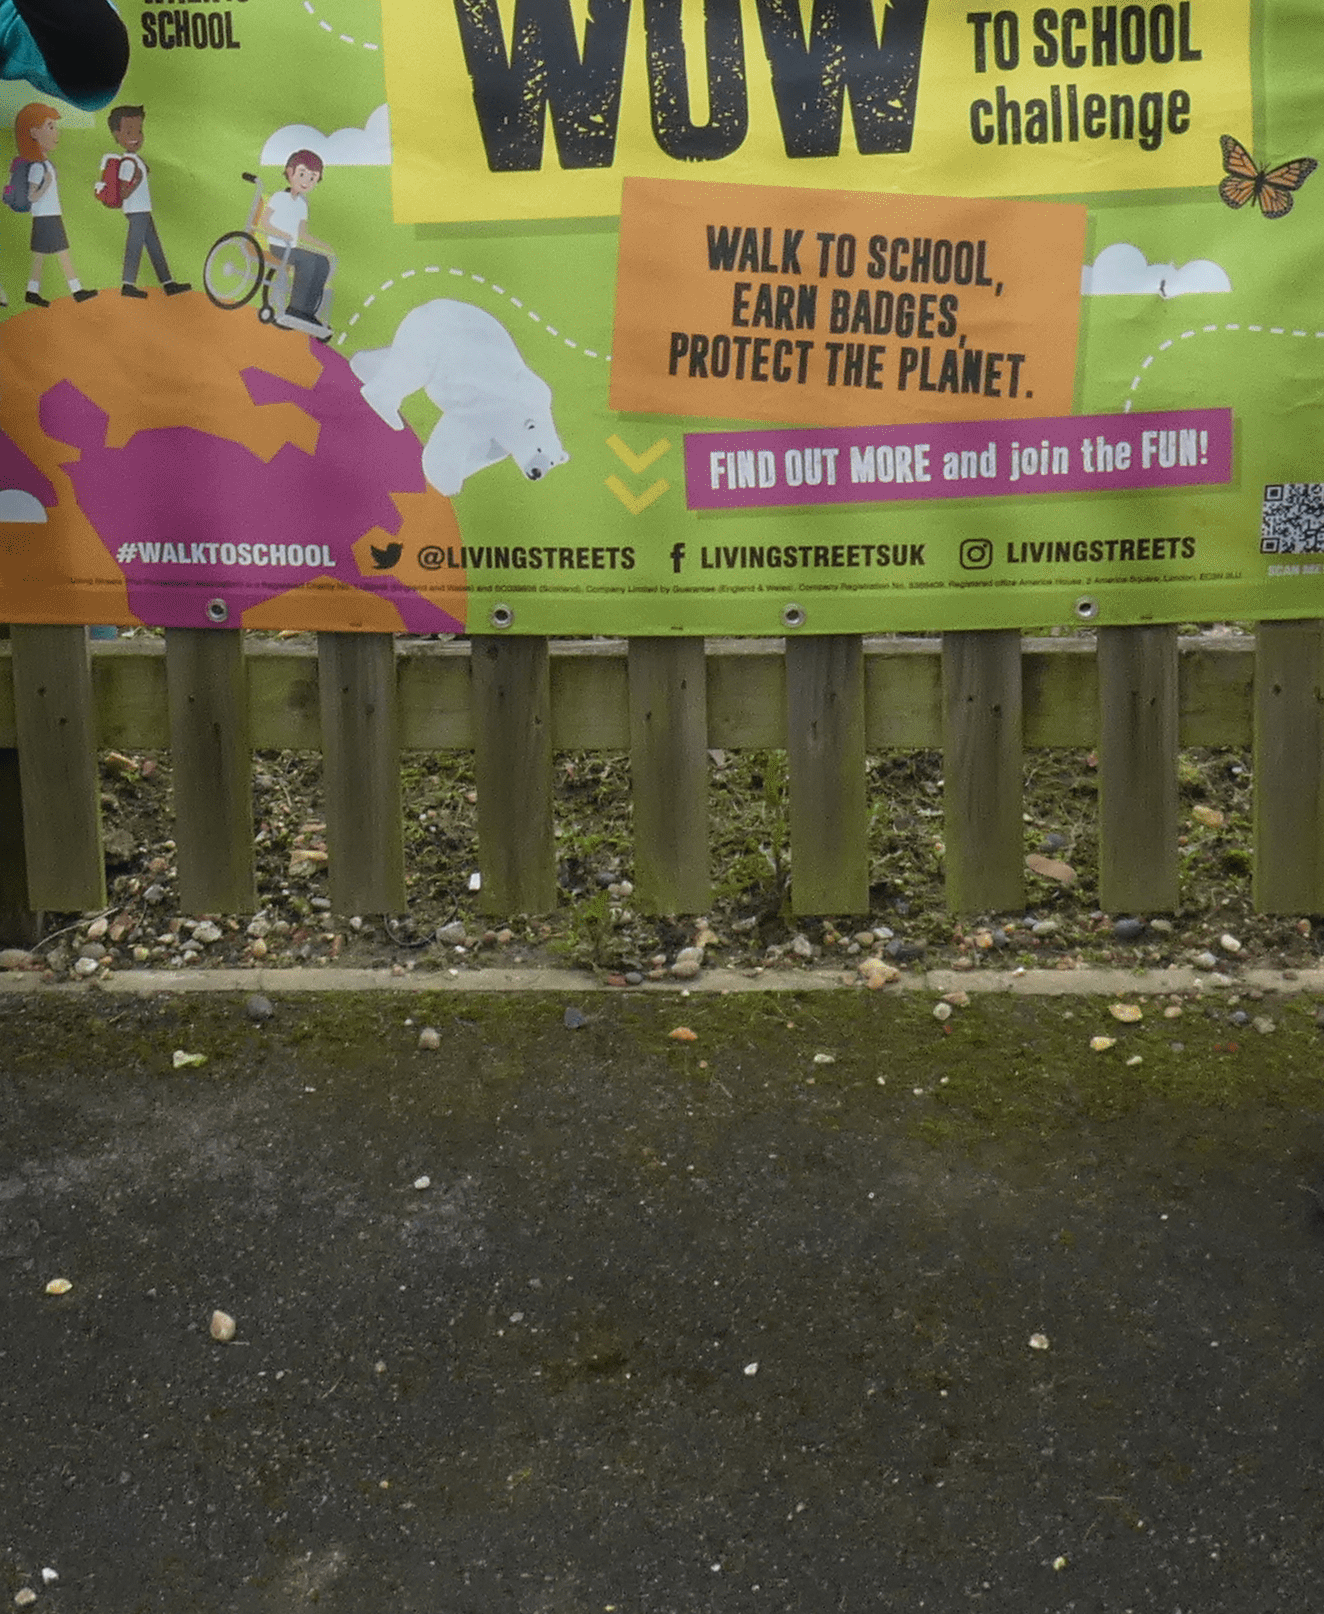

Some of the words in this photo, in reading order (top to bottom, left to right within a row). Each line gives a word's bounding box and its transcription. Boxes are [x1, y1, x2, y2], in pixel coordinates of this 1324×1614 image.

[141, 11, 241, 50] SCHOOL
[967, 12, 1020, 73] TO
[1033, 2, 1201, 68] SCHOOL
[969, 84, 1191, 152] challenge
[707, 224, 804, 276] WALK
[817, 231, 855, 278] TO
[867, 234, 1004, 296] SCHOOL,
[732, 283, 817, 332] EARN
[829, 287, 967, 349] BADGES,
[669, 331, 810, 384] PROTECT
[825, 340, 883, 389] THE
[898, 346, 1034, 398] PLANET.
[709, 449, 776, 491] FIND
[784, 446, 838, 487] OUT
[850, 444, 931, 485] MORE
[942, 442, 997, 481] and
[1009, 438, 1069, 481] join
[1080, 433, 1132, 473] the
[1141, 429, 1209, 469] FUN!
[116, 542, 336, 568] #WALKTOSCHOOL
[417, 546, 635, 570] @LIVINGSTREETS
[701, 542, 925, 569] LIVINGSTREETSUK
[1006, 536, 1196, 566] LIVINGSTREETS
